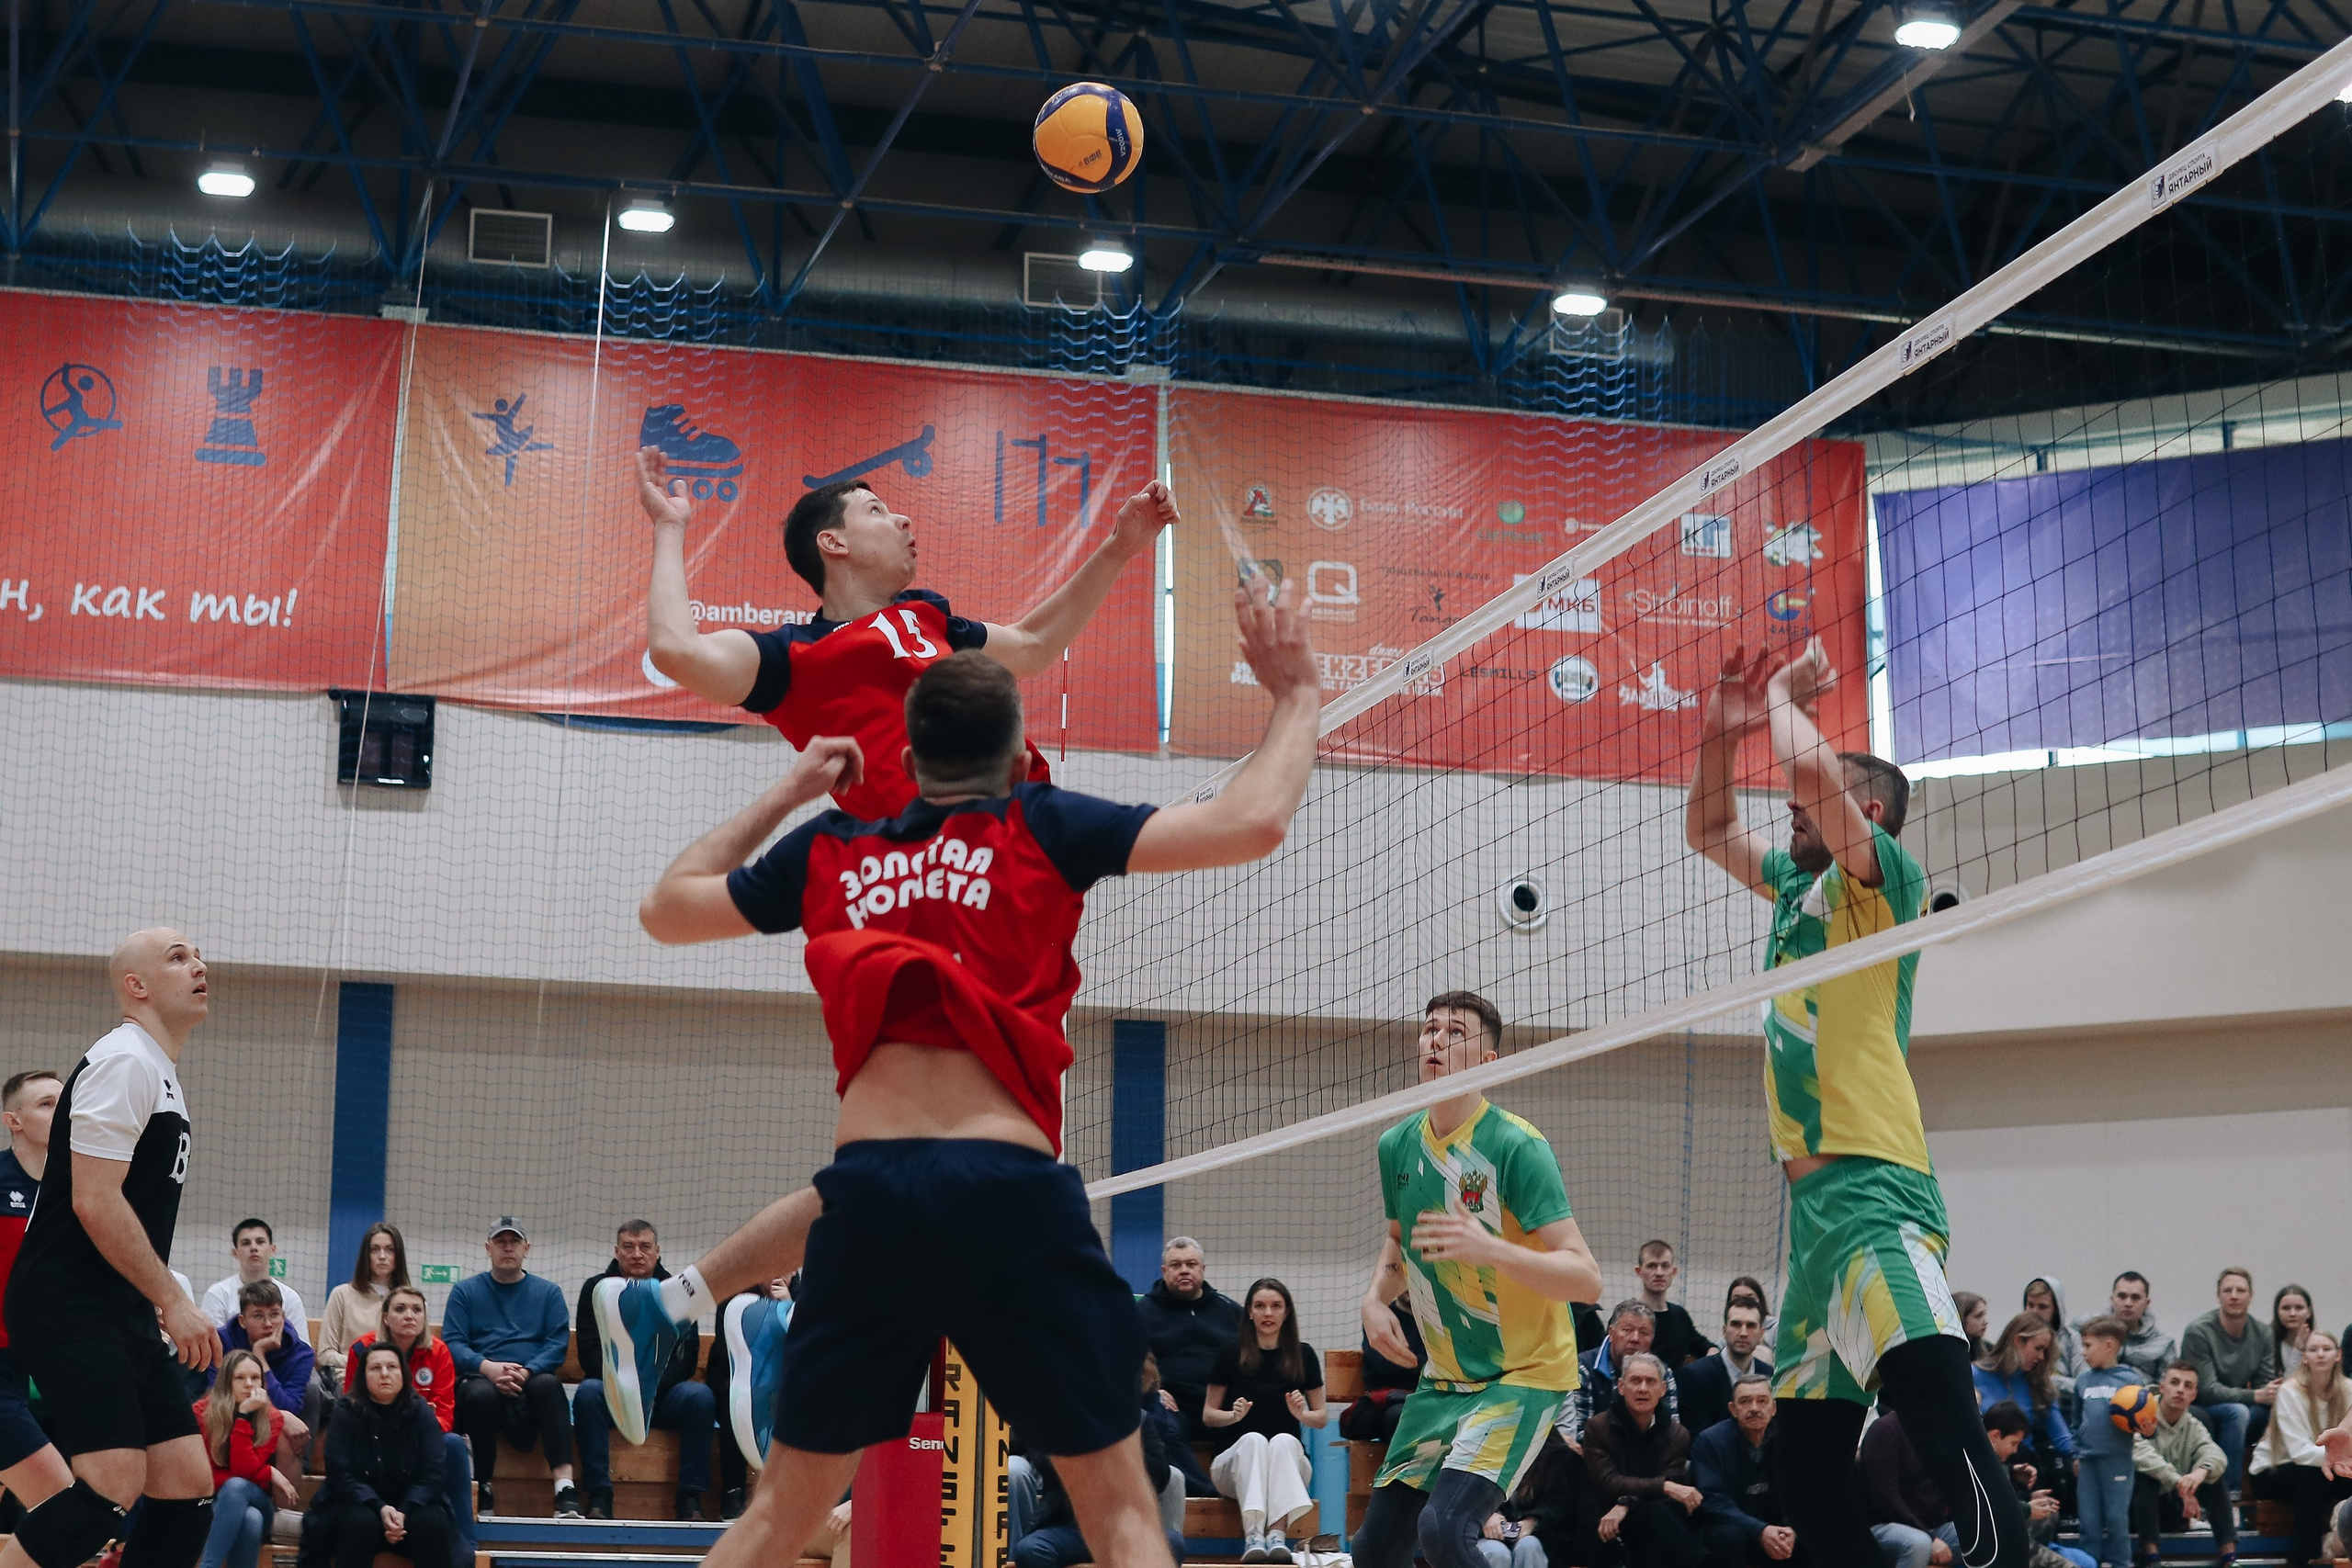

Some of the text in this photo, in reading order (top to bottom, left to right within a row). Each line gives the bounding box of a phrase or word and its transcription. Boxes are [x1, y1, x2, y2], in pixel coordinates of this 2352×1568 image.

[2168, 156, 2212, 196] ЯНТАРНЫЙ
[1914, 327, 1951, 359] ЯНТАРНЫЙ
[1711, 461, 1740, 489] ЯНТАРНЫЙ
[70, 582, 166, 621] как
[189, 588, 298, 628] ты!
[1548, 596, 1595, 614] МКБ
[868, 609, 938, 659] 15
